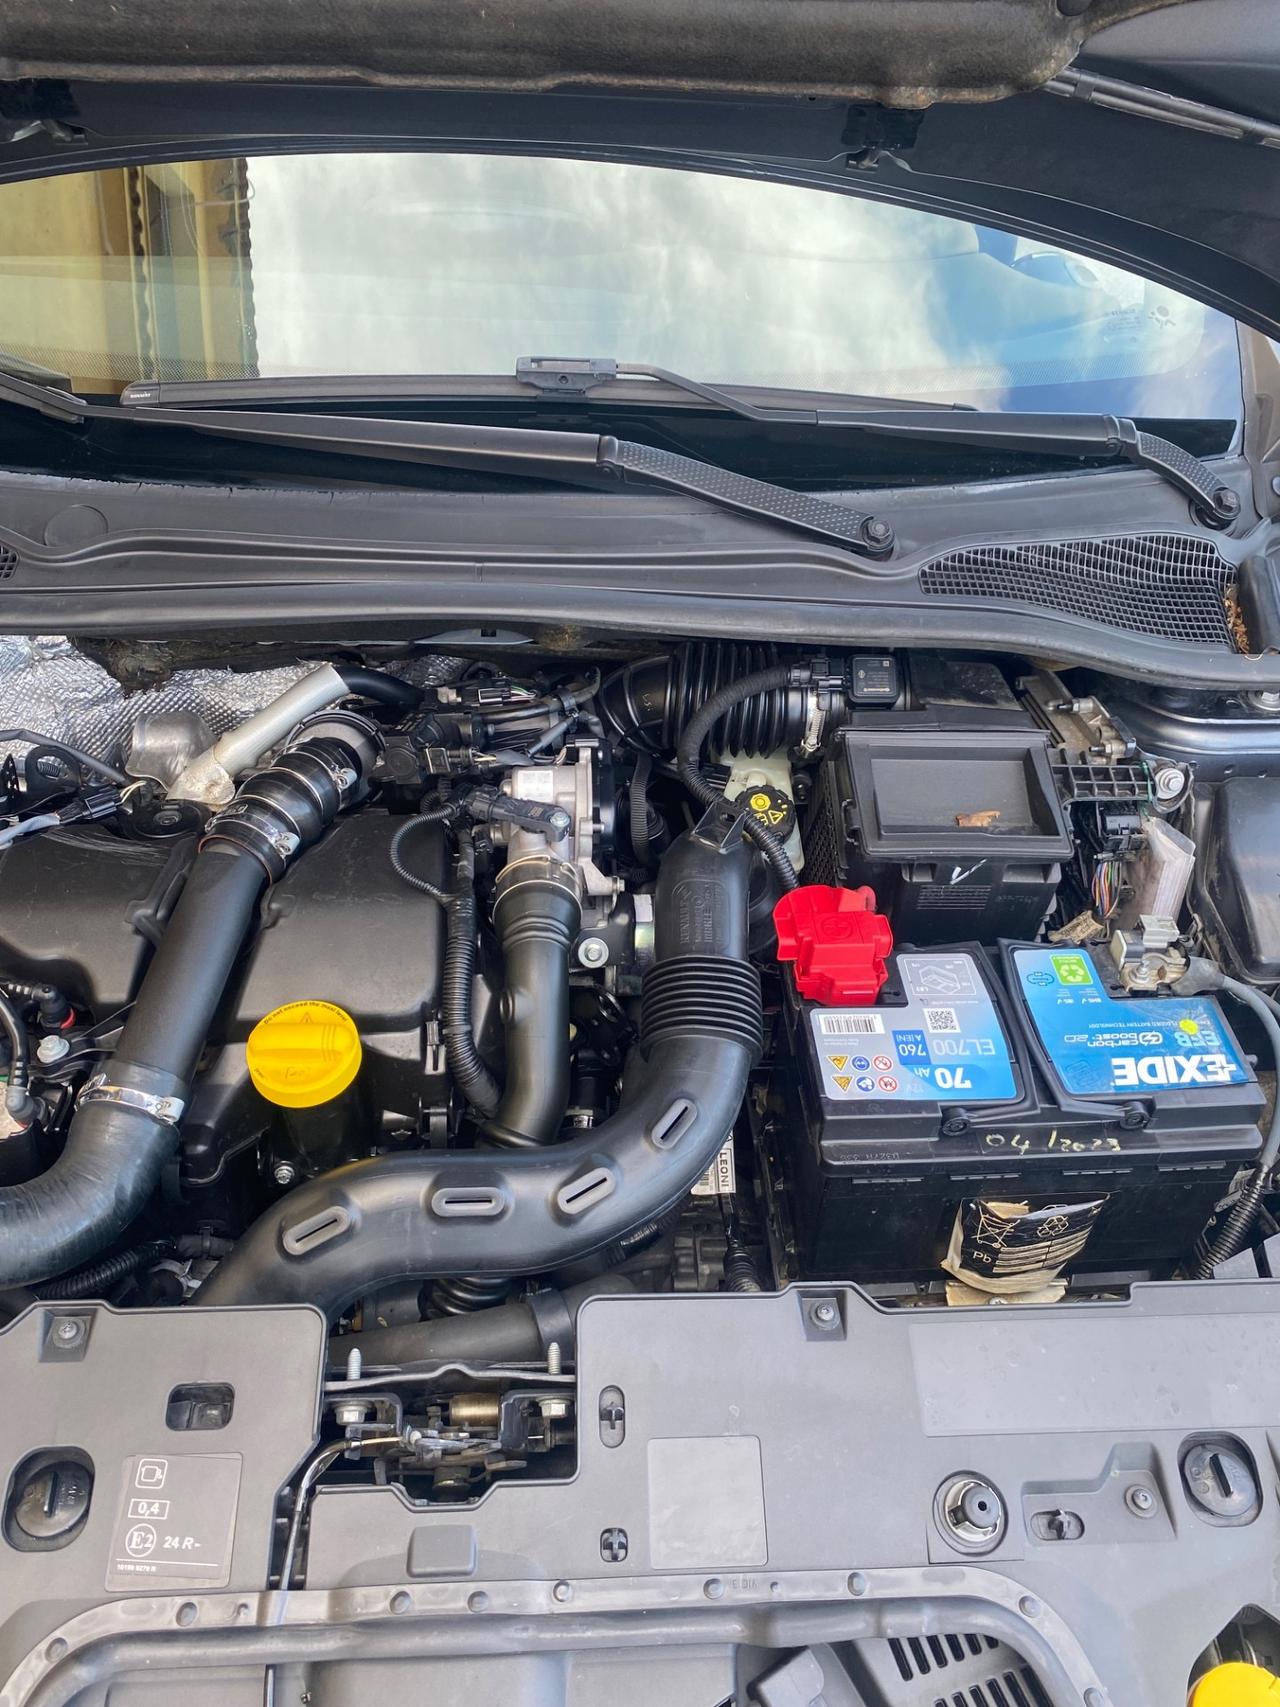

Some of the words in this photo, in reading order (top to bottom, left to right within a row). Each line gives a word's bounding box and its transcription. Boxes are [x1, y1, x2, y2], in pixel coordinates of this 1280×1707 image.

[1087, 1040, 1139, 1048] carbon
[1094, 1032, 1138, 1041] boost
[1174, 1030, 1221, 1047] EFB
[898, 1043, 926, 1057] 760
[933, 1038, 995, 1056] EL700
[914, 1067, 931, 1079] Ah
[1111, 1054, 1237, 1086] EXIDE
[934, 1067, 972, 1089] 70
[719, 1151, 730, 1188] LEONI
[972, 1251, 992, 1264] Pb
[138, 1503, 160, 1517] 0,4
[128, 1530, 155, 1550] E2
[163, 1536, 180, 1548] 24
